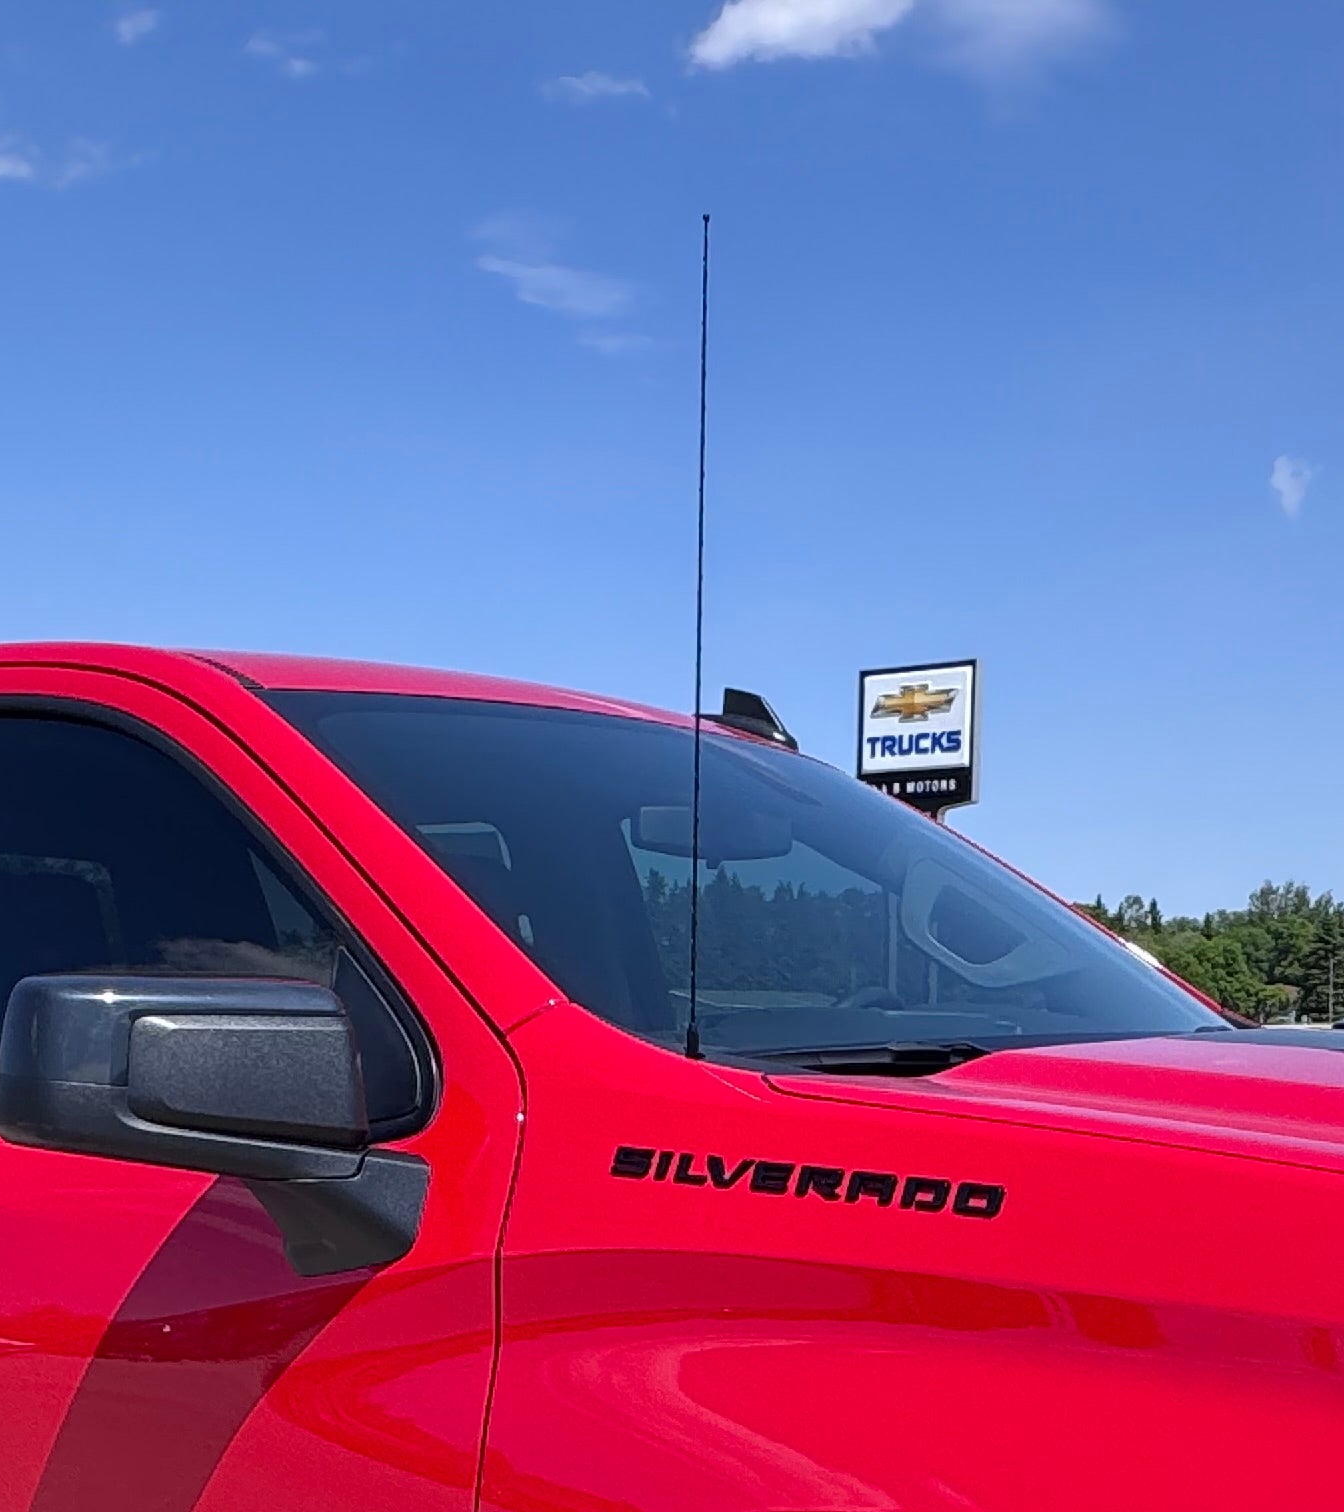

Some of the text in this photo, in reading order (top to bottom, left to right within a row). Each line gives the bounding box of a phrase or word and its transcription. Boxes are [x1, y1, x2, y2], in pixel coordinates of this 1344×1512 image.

[866, 729, 962, 759] TRUCKS
[905, 778, 956, 793] MOTORS
[610, 1144, 1007, 1220] SILVERADO
